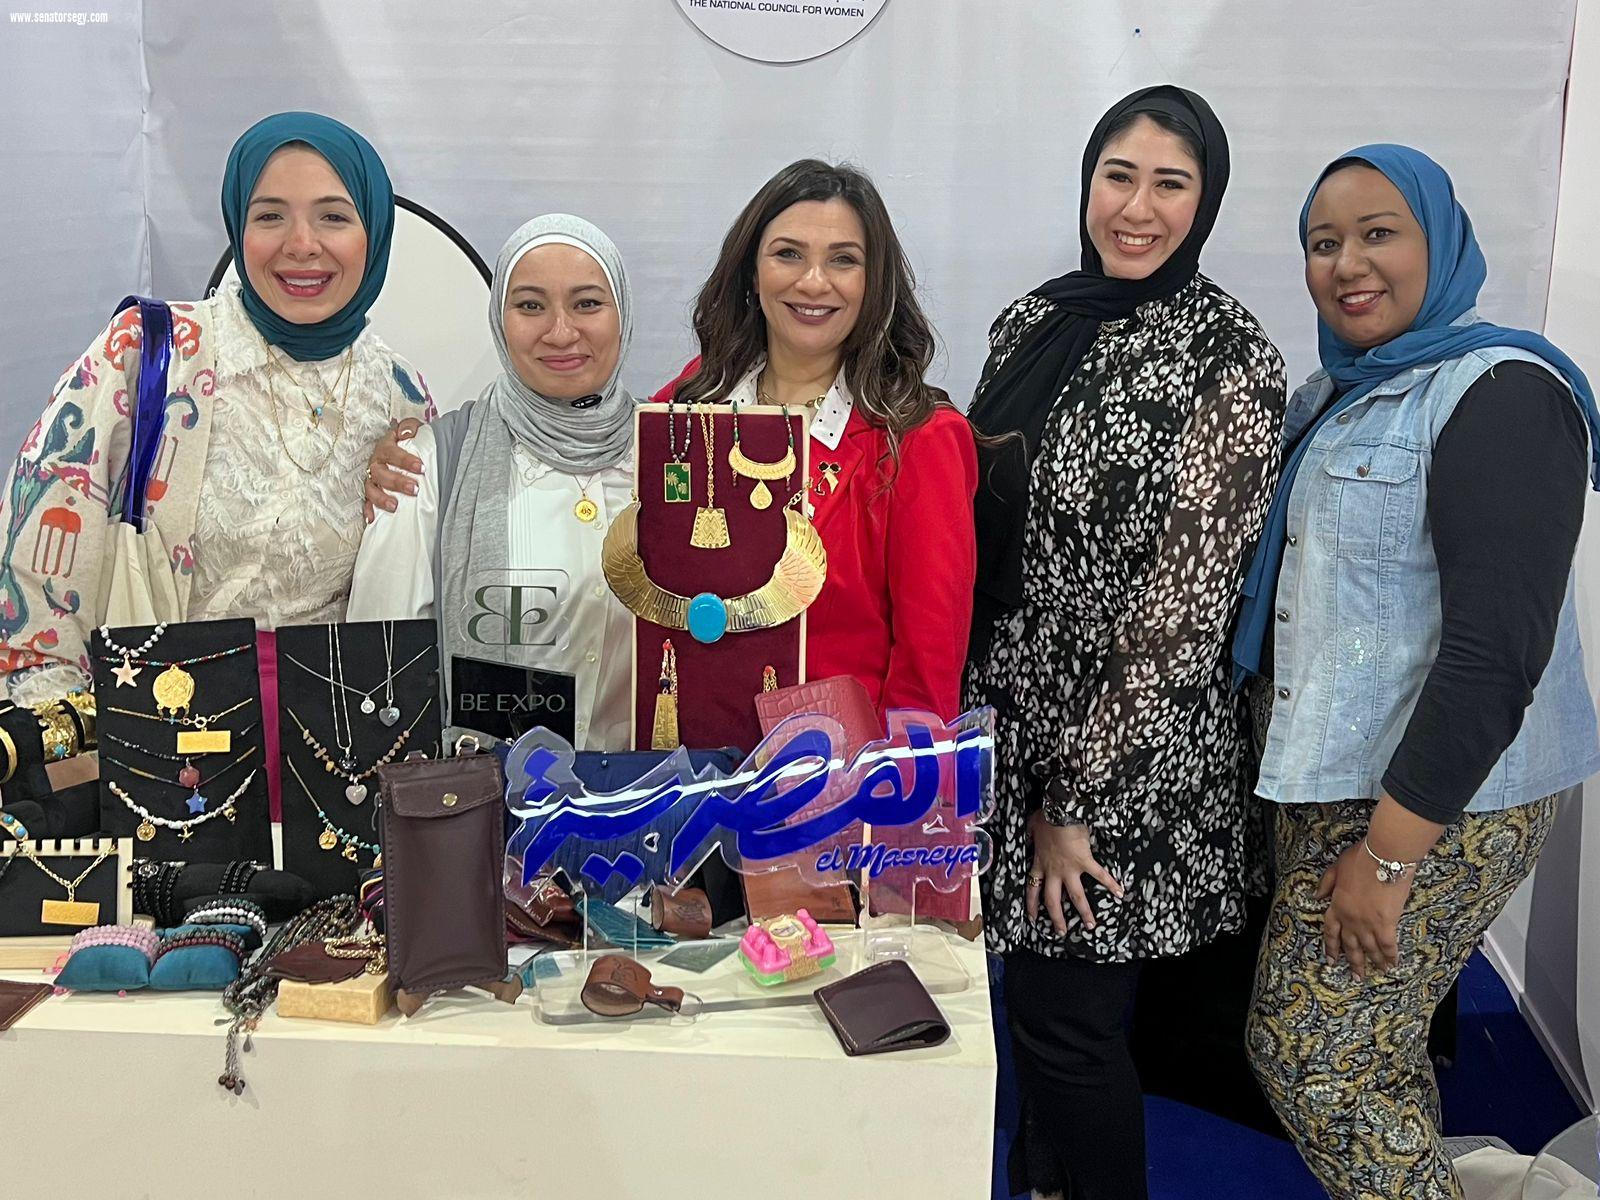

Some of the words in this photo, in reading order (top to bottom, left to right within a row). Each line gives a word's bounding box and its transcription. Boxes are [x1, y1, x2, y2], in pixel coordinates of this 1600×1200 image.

[709, 0, 756, 11] NATIONAL
[758, 3, 800, 14] COUNCIL
[802, 5, 822, 15] FOR
[824, 6, 865, 18] WOMEN
[460, 693, 491, 712] BE
[496, 693, 566, 713] EXPO
[521, 723, 982, 887] المصرية
[814, 844, 844, 873] el
[845, 841, 980, 879] Masreya
